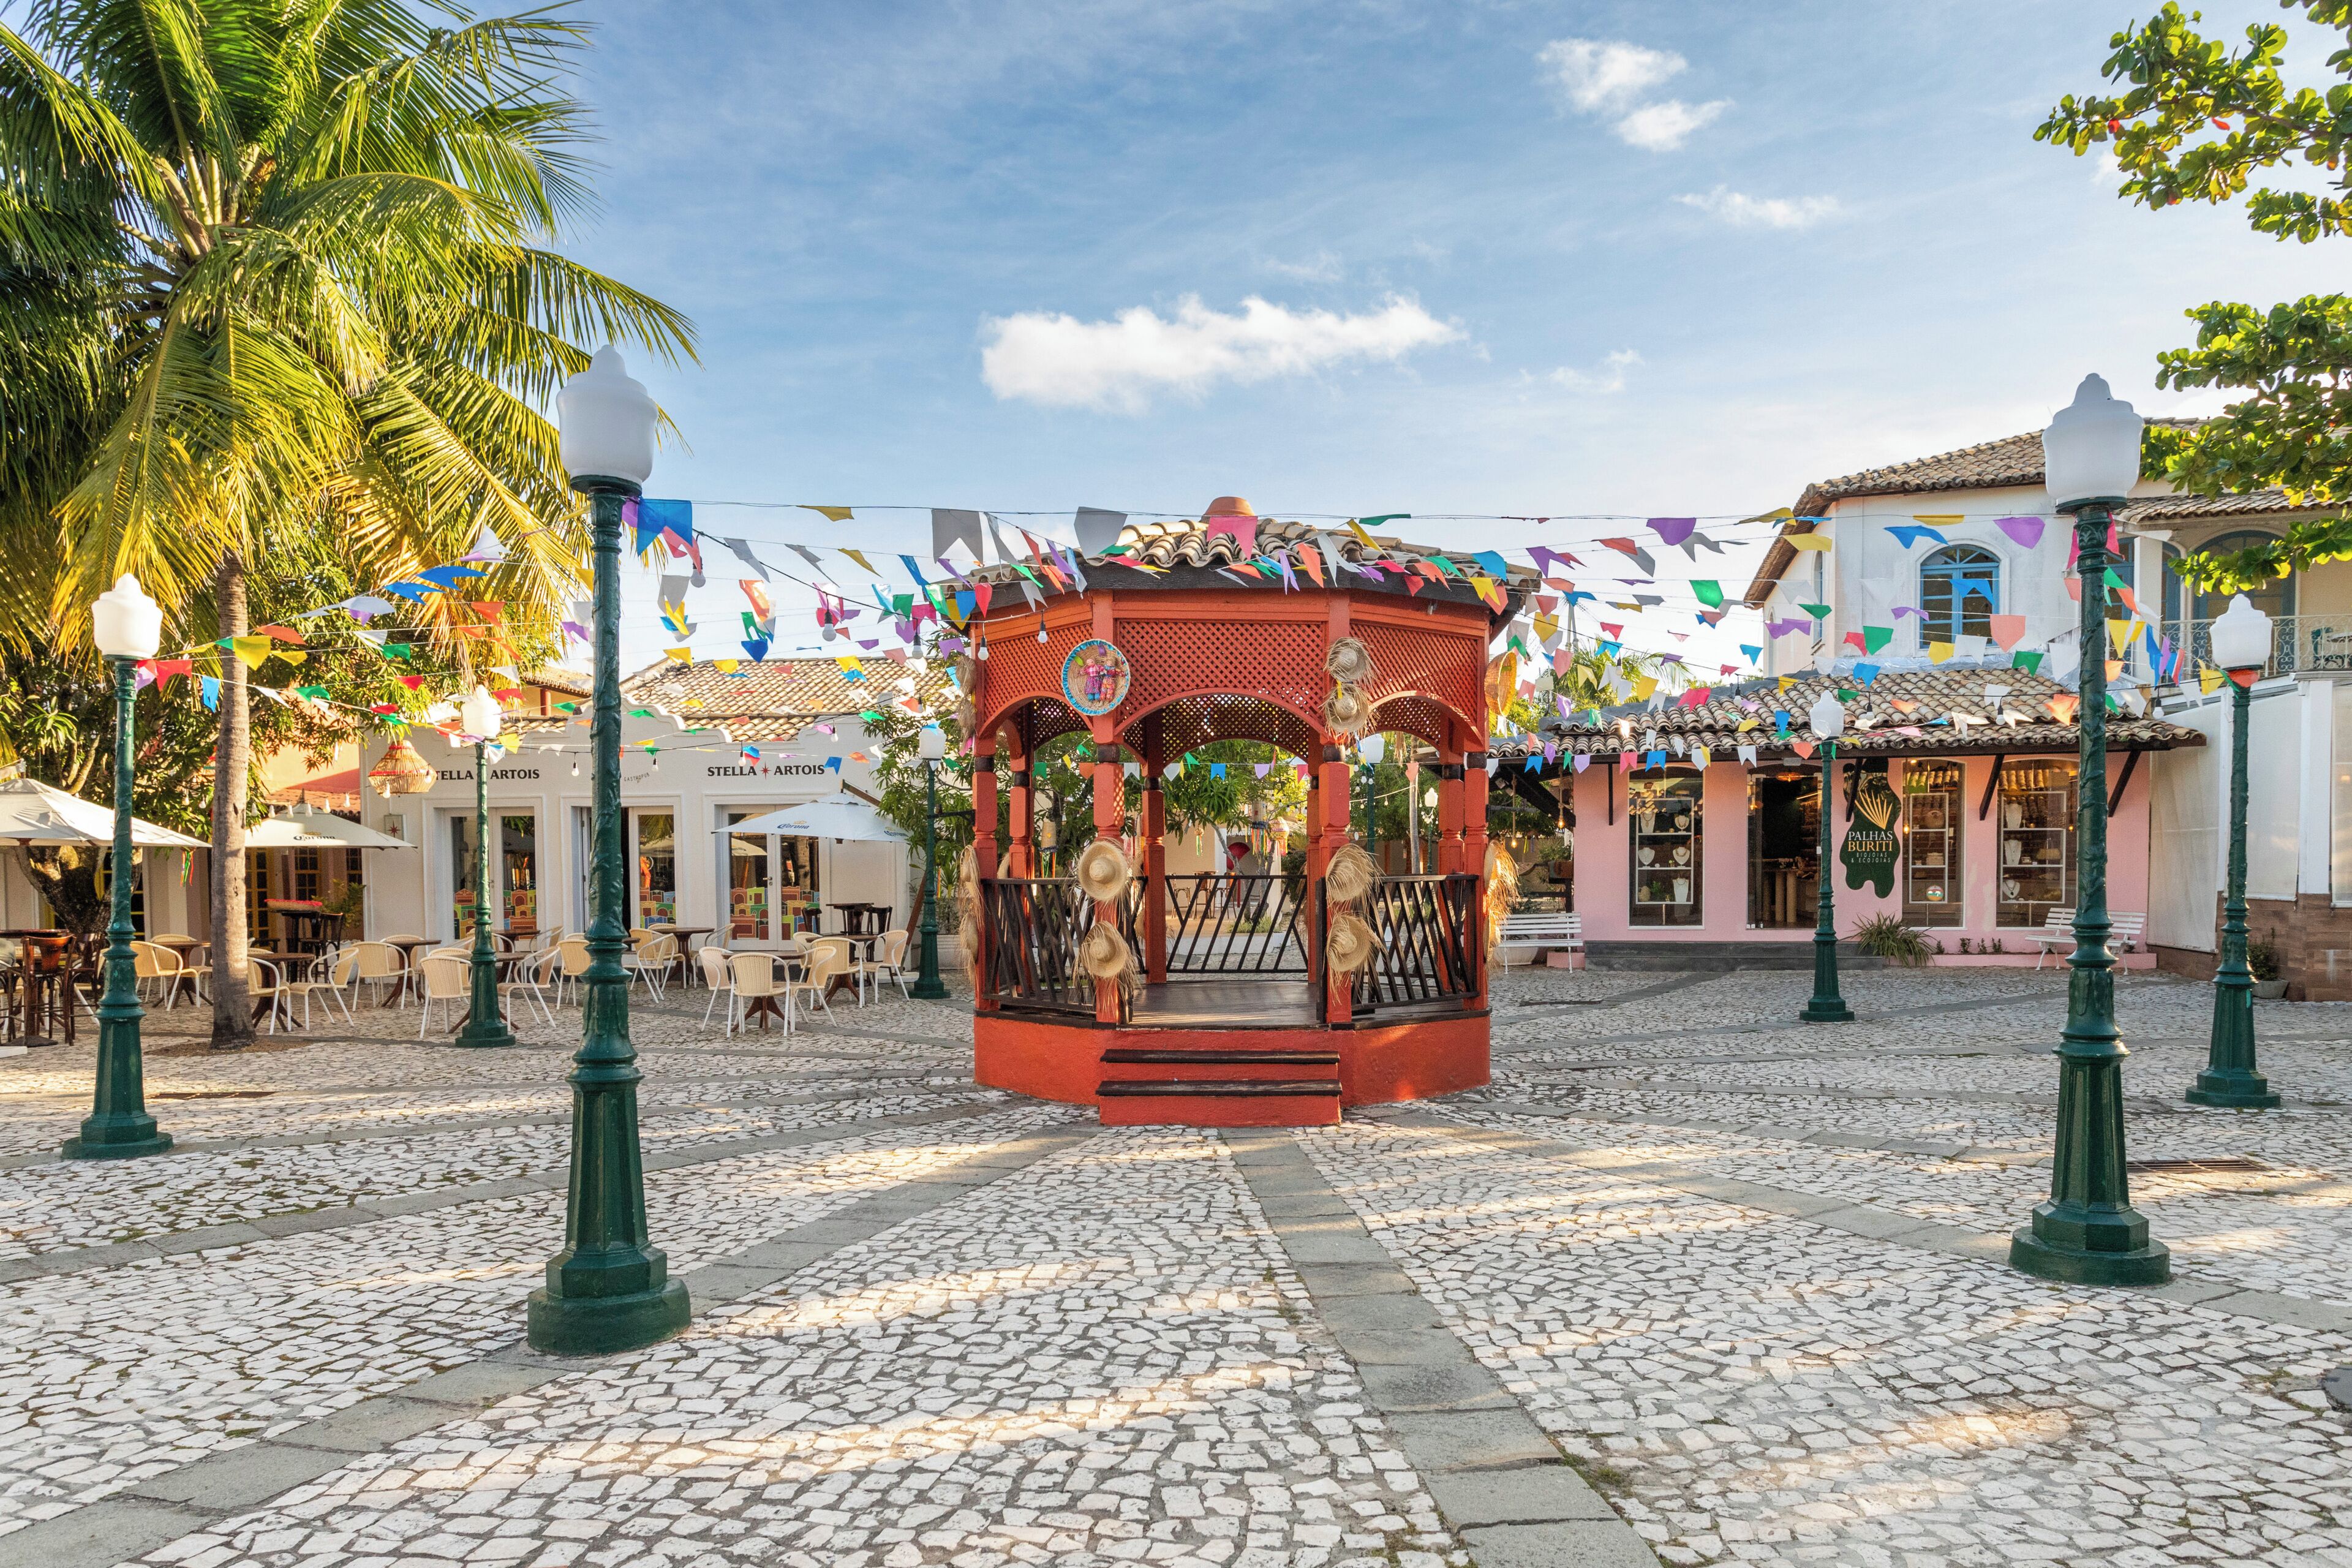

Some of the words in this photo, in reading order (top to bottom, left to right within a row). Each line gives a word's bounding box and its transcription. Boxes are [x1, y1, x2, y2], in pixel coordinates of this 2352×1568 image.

[435, 771, 474, 780] TELLA
[491, 769, 540, 779] ARTOIS
[707, 766, 757, 776] STELLA
[774, 765, 825, 775] ARTOIS
[624, 772, 650, 782] GASTROPUB
[1849, 831, 1893, 840] PALHAS
[1848, 841, 1893, 851] BURITI
